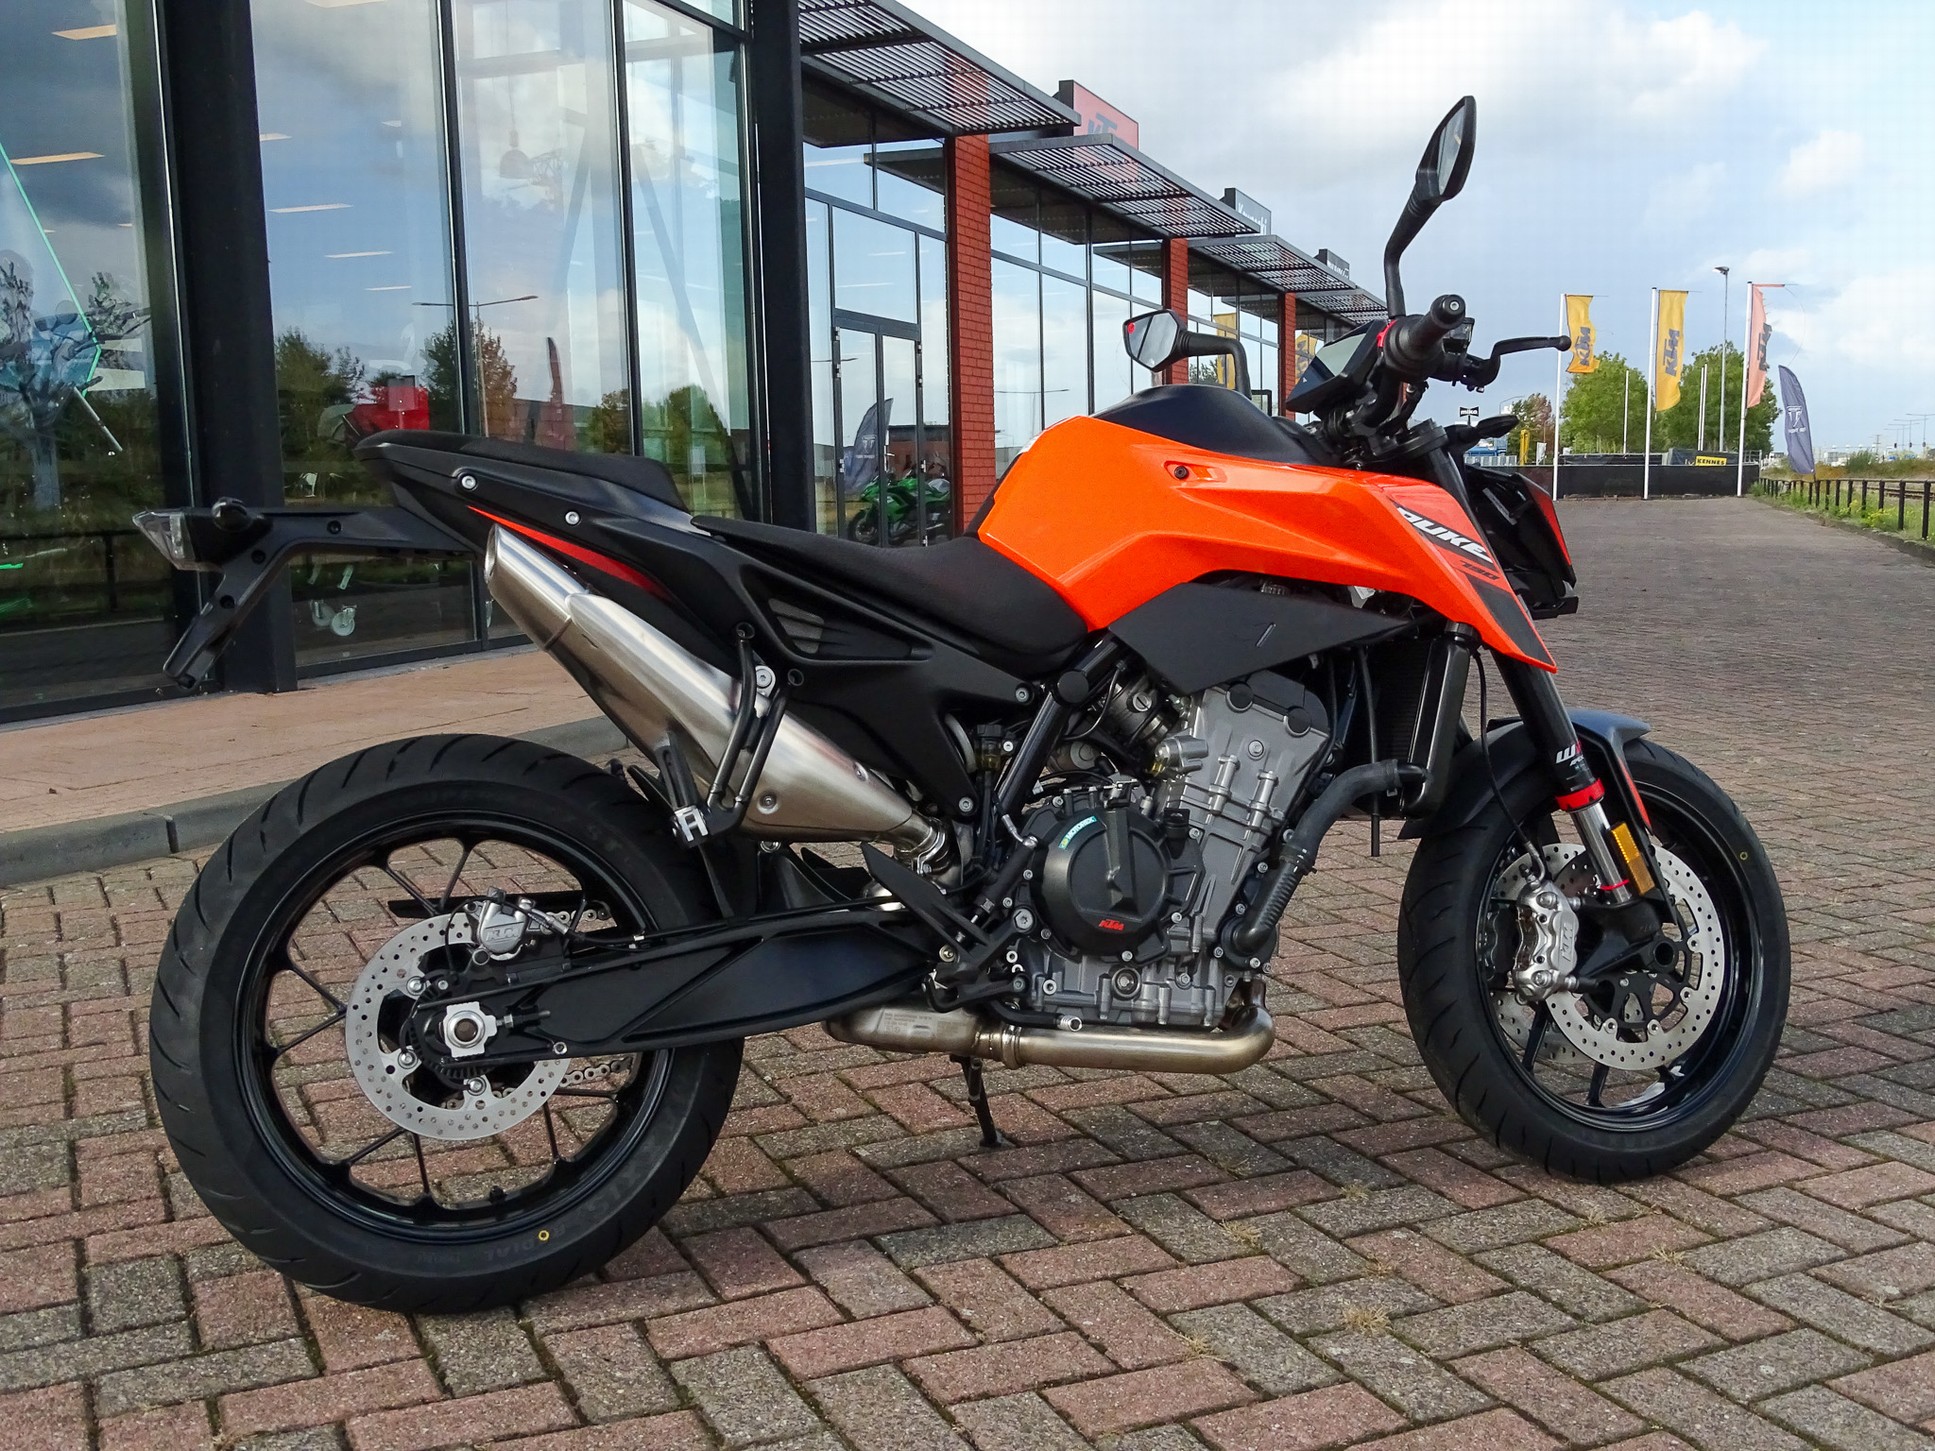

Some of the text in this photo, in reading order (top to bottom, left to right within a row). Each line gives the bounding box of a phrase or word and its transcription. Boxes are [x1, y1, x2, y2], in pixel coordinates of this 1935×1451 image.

[1087, 112, 1118, 135] KT
[1574, 326, 1591, 366] KTM
[1663, 328, 1680, 376] KTM
[1757, 323, 1773, 371] KTM
[1397, 507, 1494, 564] DUKE
[485, 927, 520, 941] KTM
[1099, 919, 1124, 931] KTM
[1560, 922, 1574, 962] KTM
